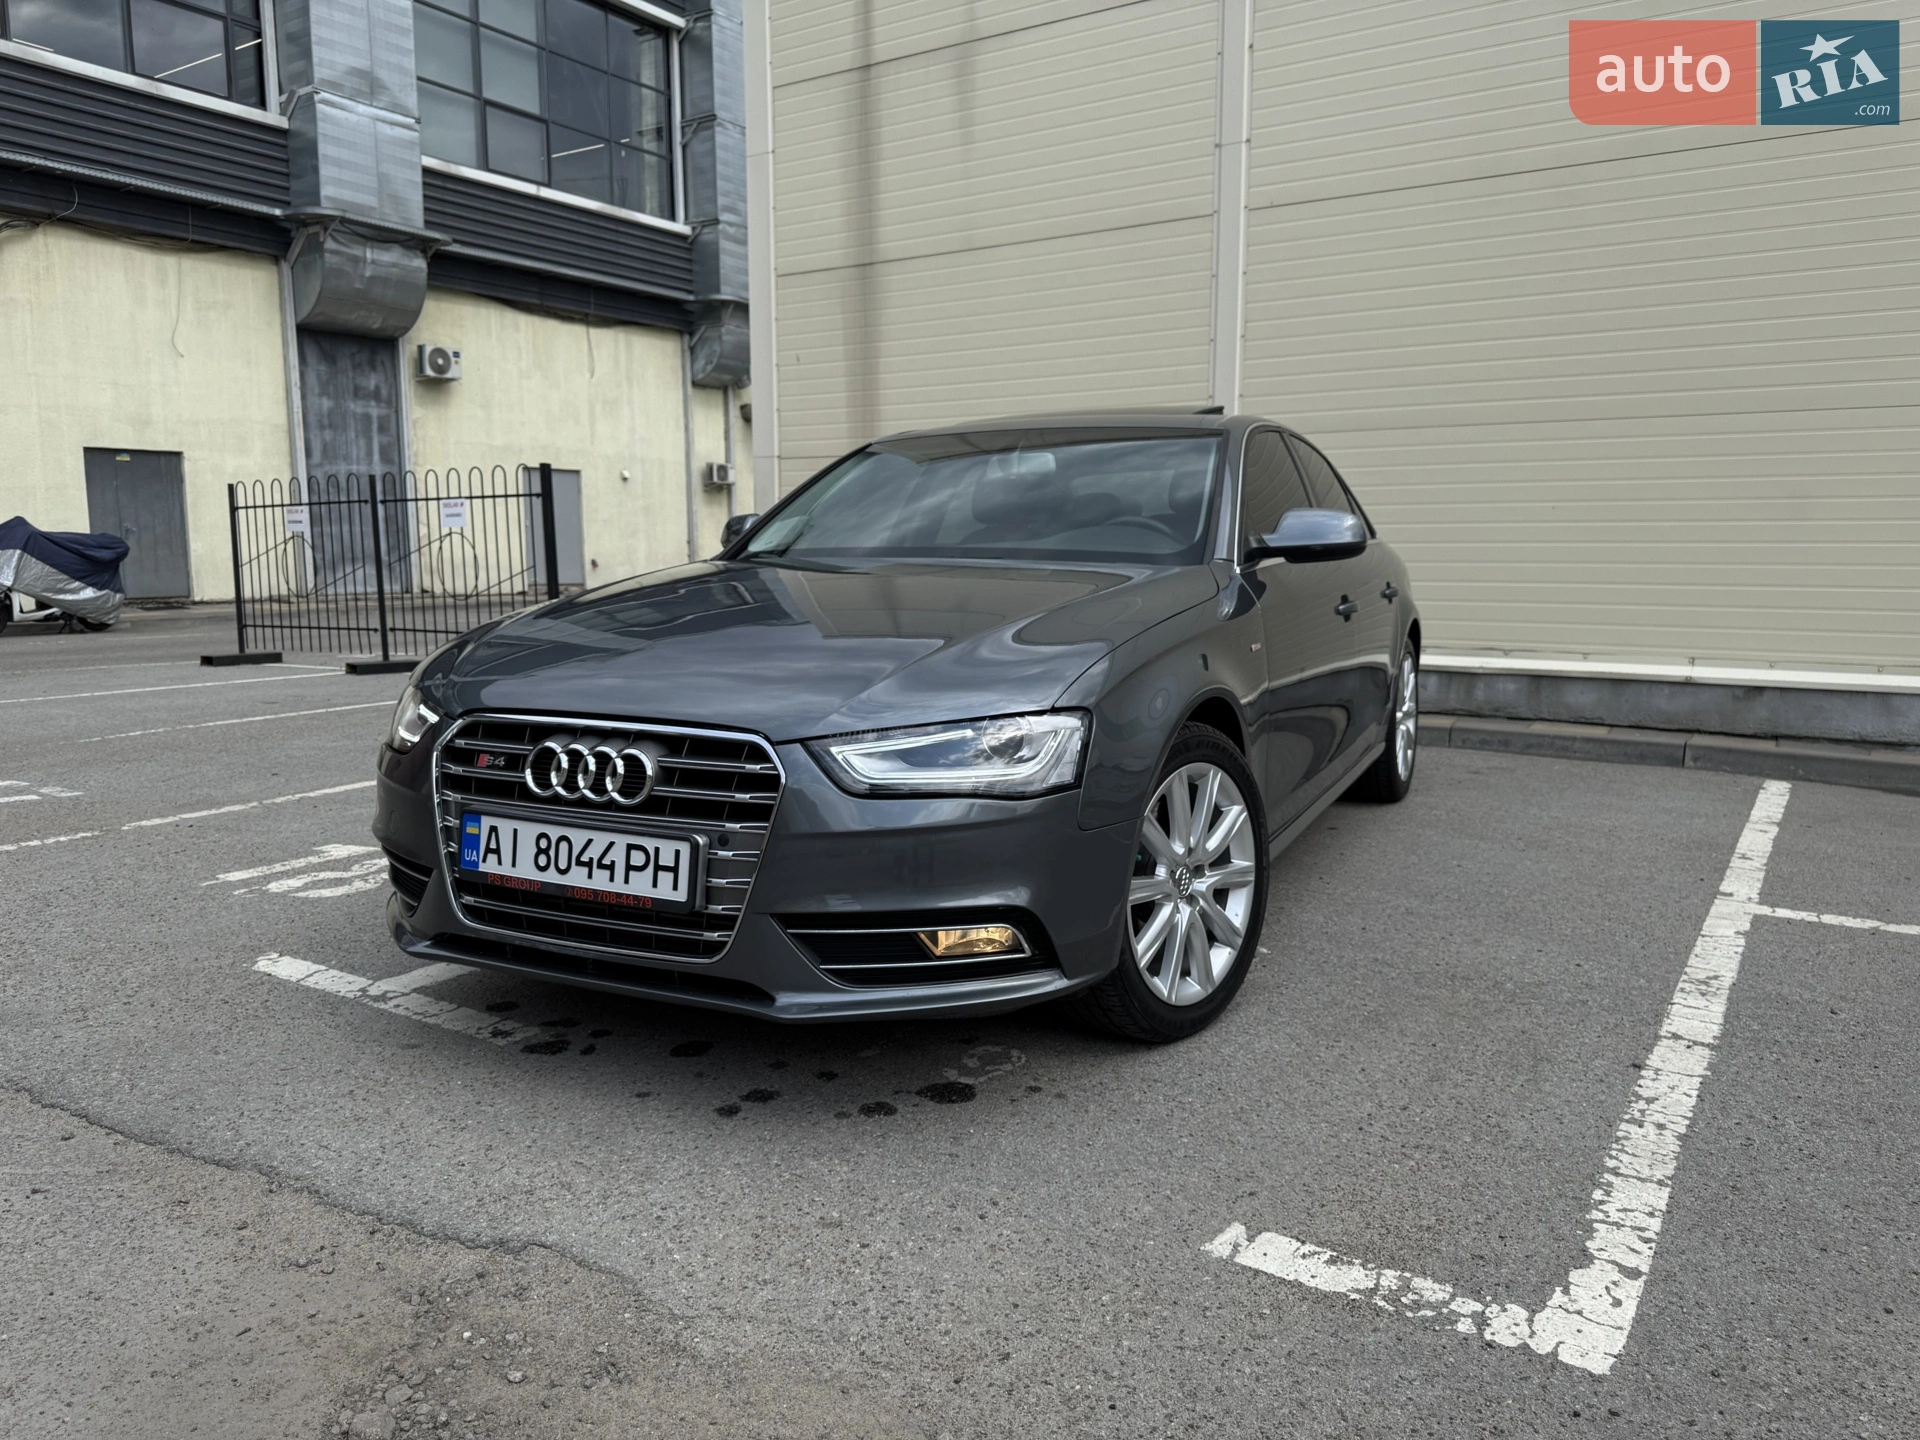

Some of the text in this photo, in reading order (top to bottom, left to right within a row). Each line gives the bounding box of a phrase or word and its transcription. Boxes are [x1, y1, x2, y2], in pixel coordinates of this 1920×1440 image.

[464, 849, 478, 862] UA
[481, 825, 518, 868] AI
[487, 873, 541, 892] PS GROUP
[574, 887, 652, 908] 095 708-44-79
